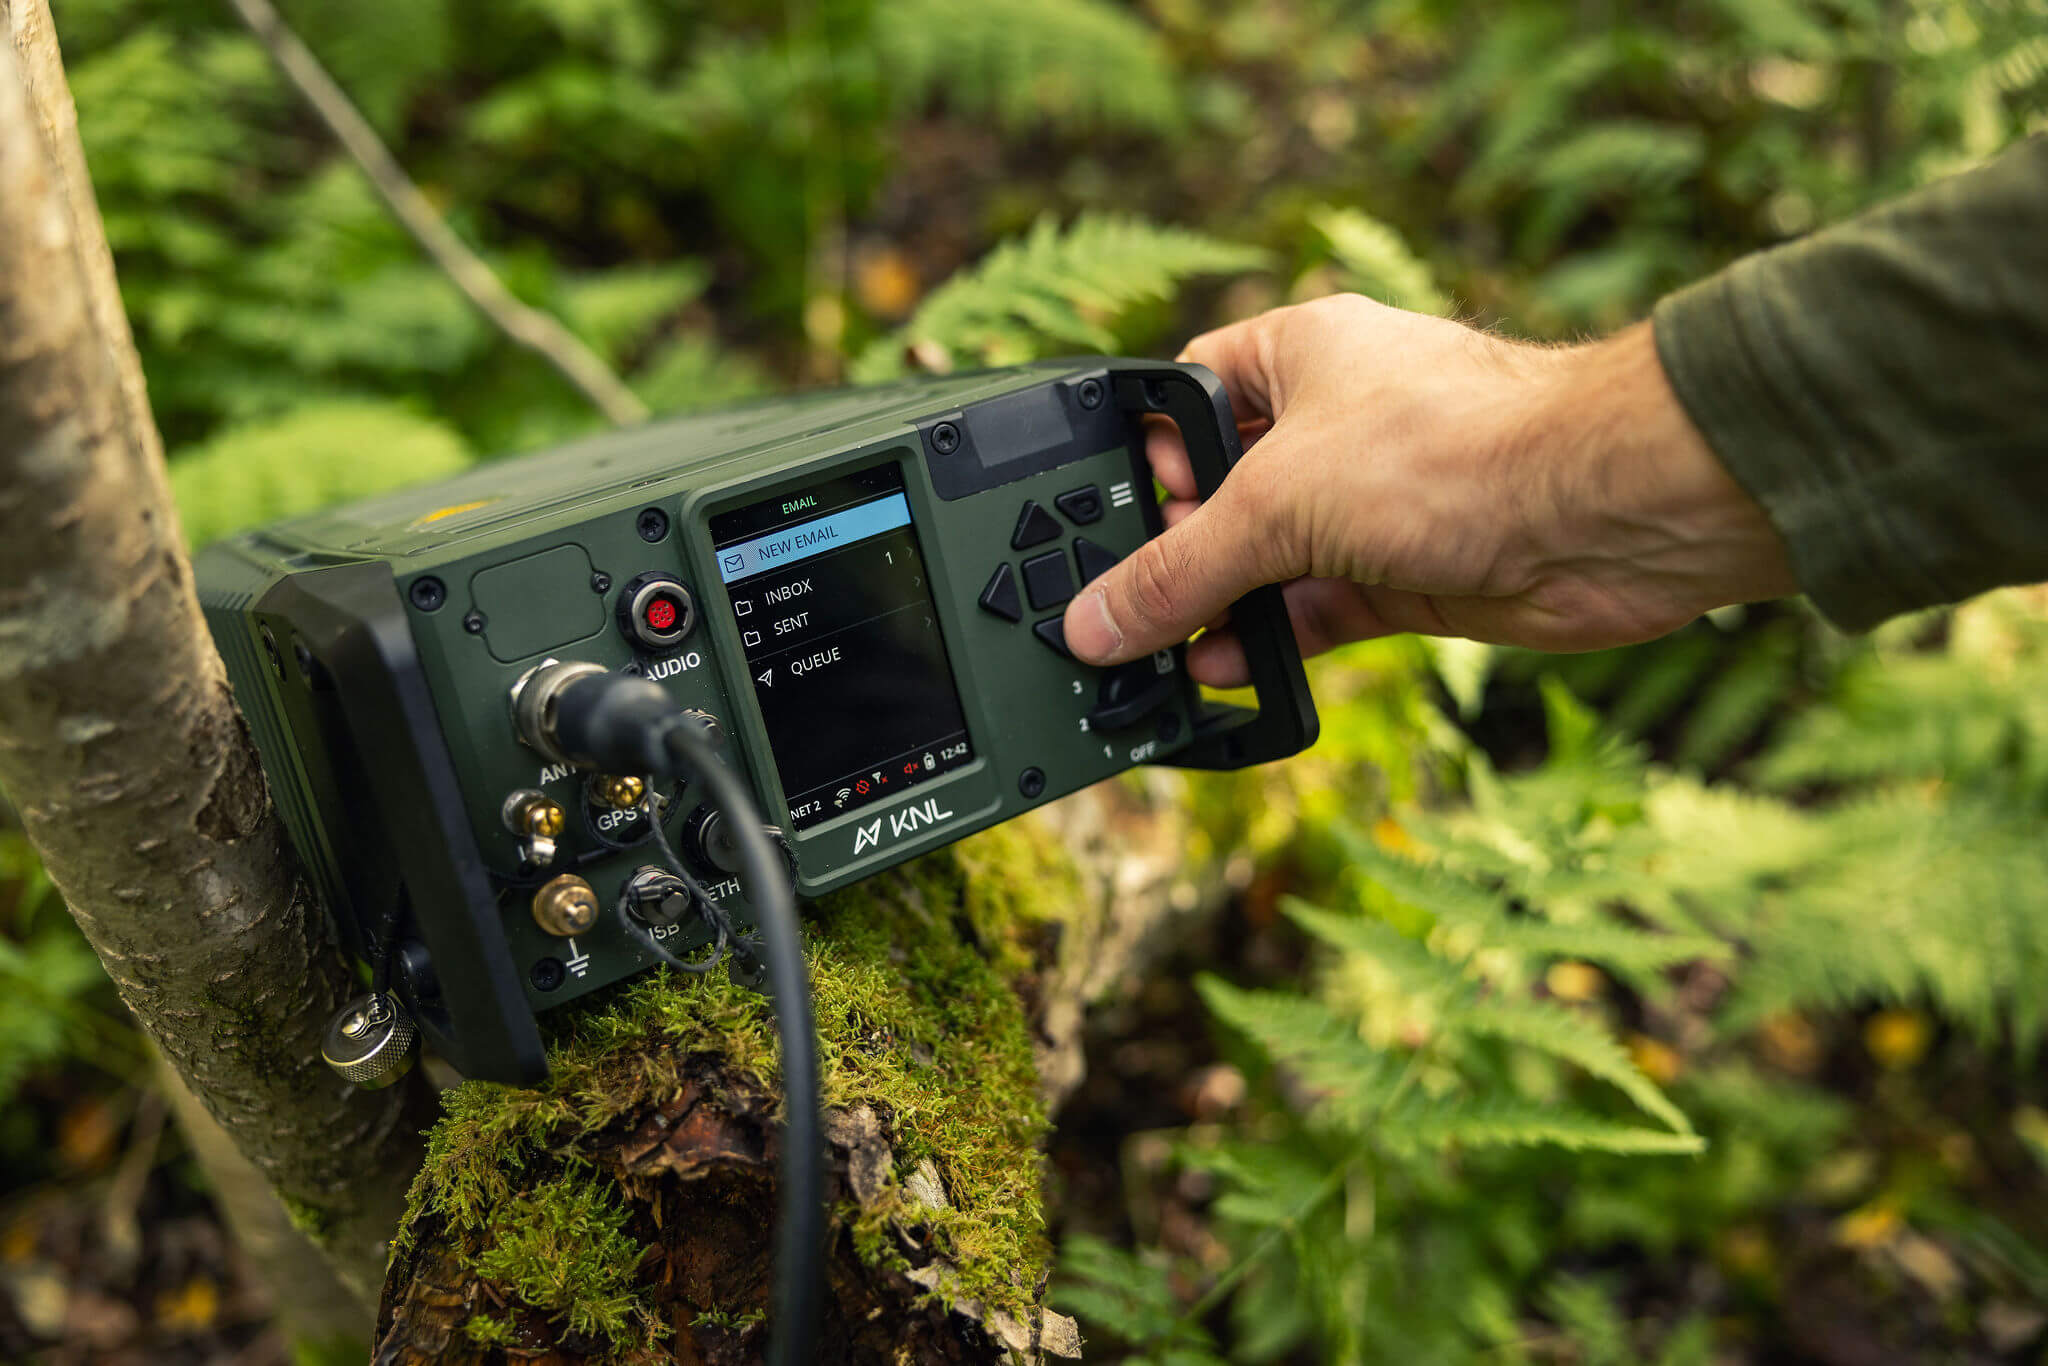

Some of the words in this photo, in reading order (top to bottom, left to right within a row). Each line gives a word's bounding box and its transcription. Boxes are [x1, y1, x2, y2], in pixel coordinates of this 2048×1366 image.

[781, 495, 818, 515] EMAIL
[758, 539, 793, 561] NEW
[795, 525, 839, 549] EMAIL
[764, 578, 814, 606] INBOX
[884, 551, 894, 565] 1
[773, 611, 810, 636] SENT
[790, 646, 842, 676] QUEUE
[1072, 680, 1083, 695] 3
[1079, 717, 1090, 732] 2
[1103, 744, 1113, 759] 1
[1130, 740, 1156, 762] OFF
[597, 806, 638, 831] GPS
[790, 804, 812, 821] NET
[813, 800, 823, 812] 2
[889, 798, 954, 839] KNL
[706, 877, 741, 902] ETH
